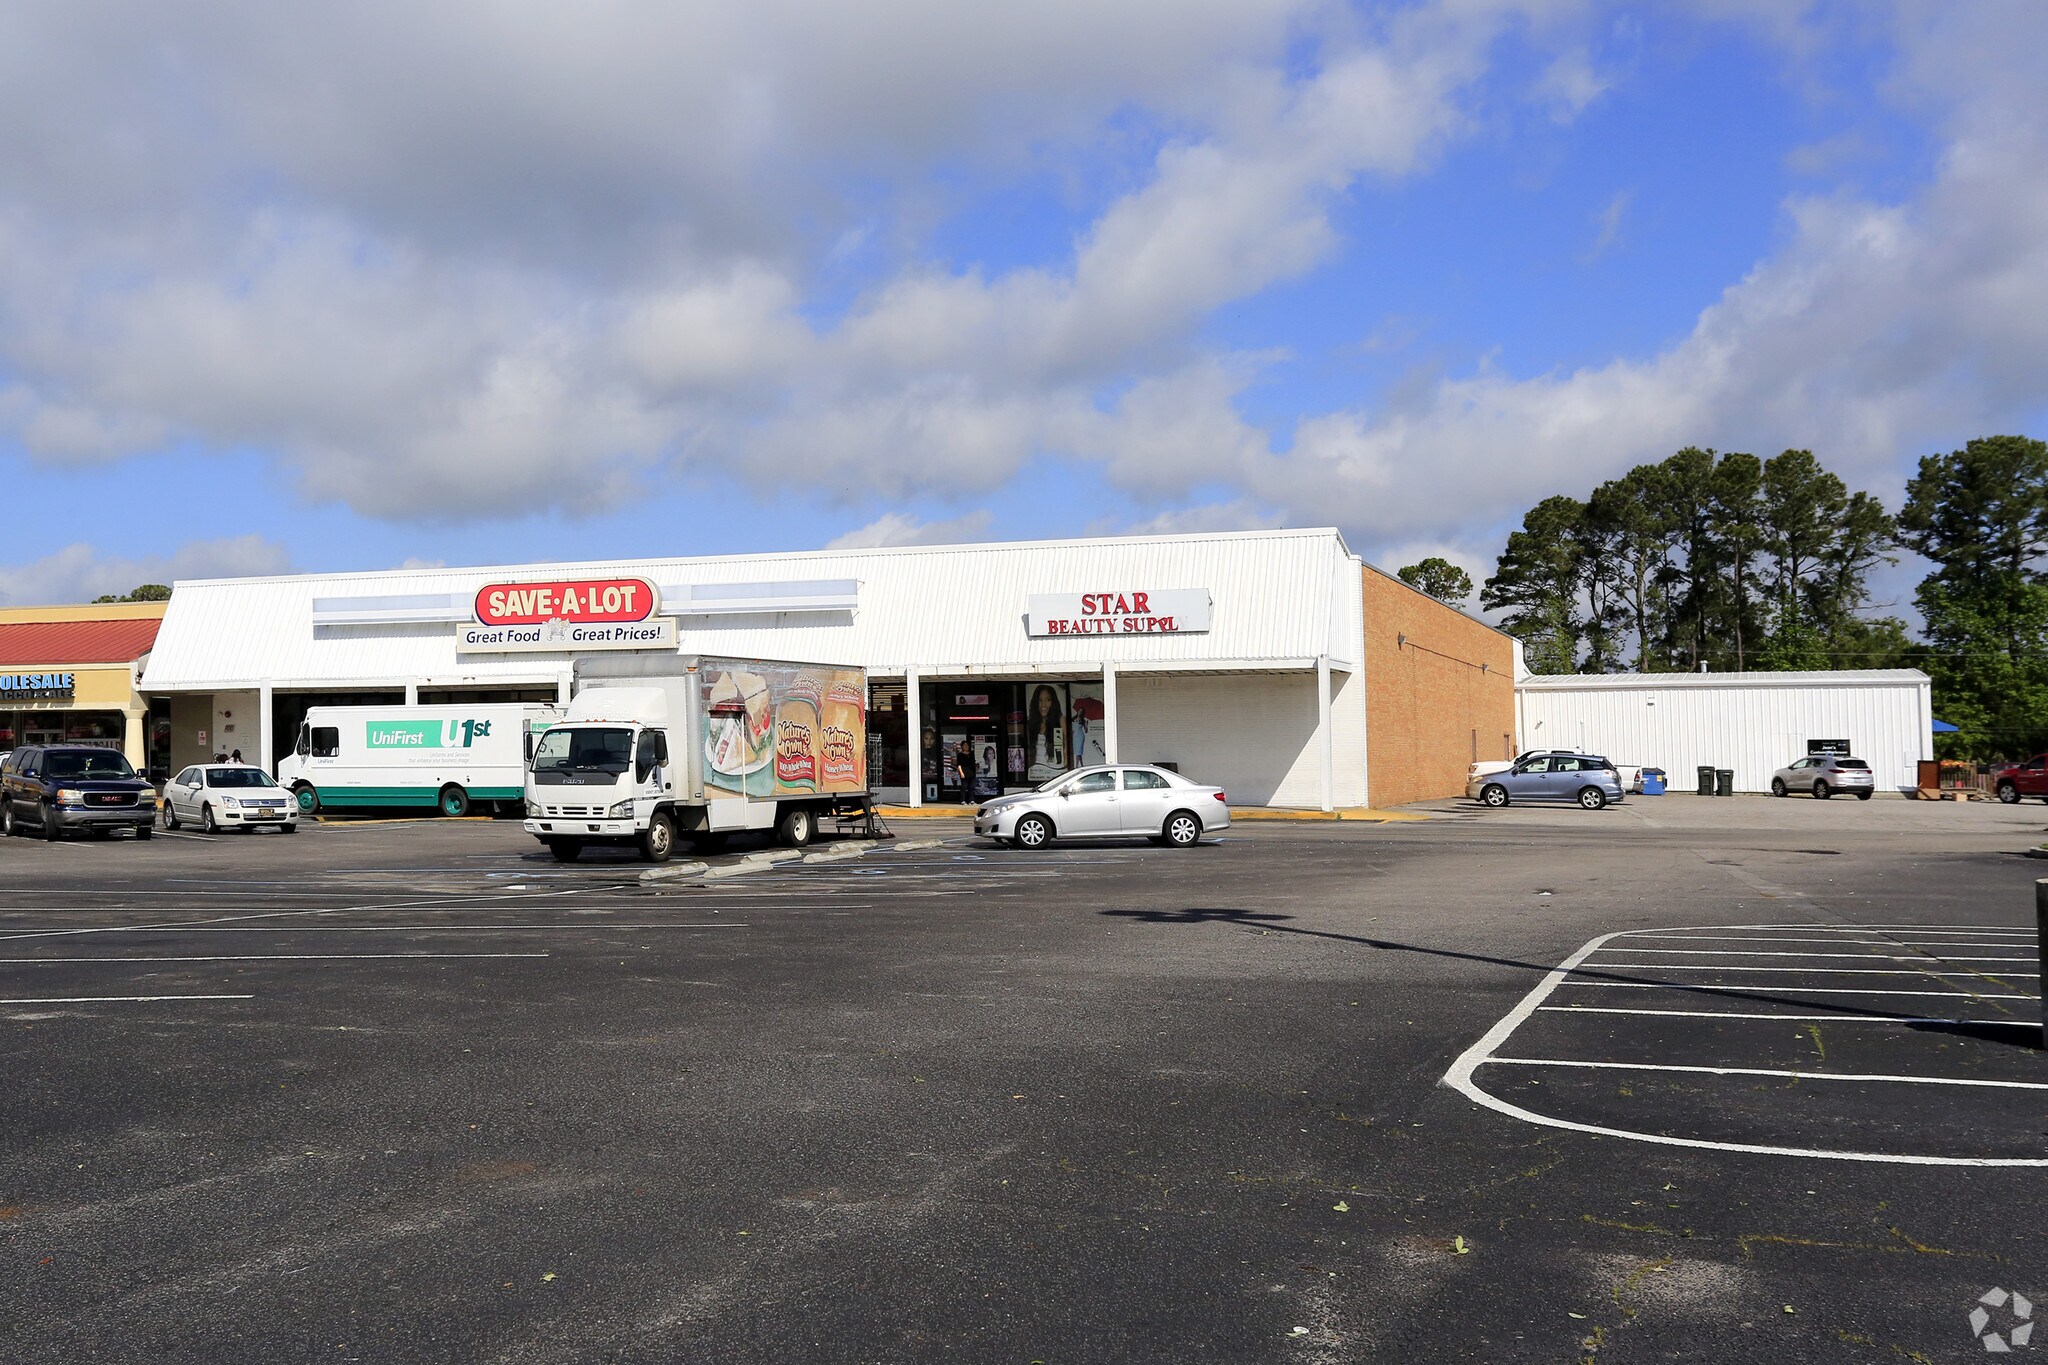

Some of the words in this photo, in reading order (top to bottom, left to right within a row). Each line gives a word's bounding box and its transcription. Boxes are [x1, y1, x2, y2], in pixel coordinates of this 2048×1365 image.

[1081, 592, 1151, 616] STAR
[466, 629, 503, 644] Great
[506, 629, 541, 643] Food
[572, 627, 611, 642] Great
[614, 626, 661, 642] Prices!
[1047, 618, 1119, 635] BEAUTY
[372, 730, 424, 745] UniFirst
[777, 720, 811, 746] Nature's
[821, 726, 855, 752] Nature's
[783, 739, 804, 760] Own
[829, 745, 847, 762] Own
